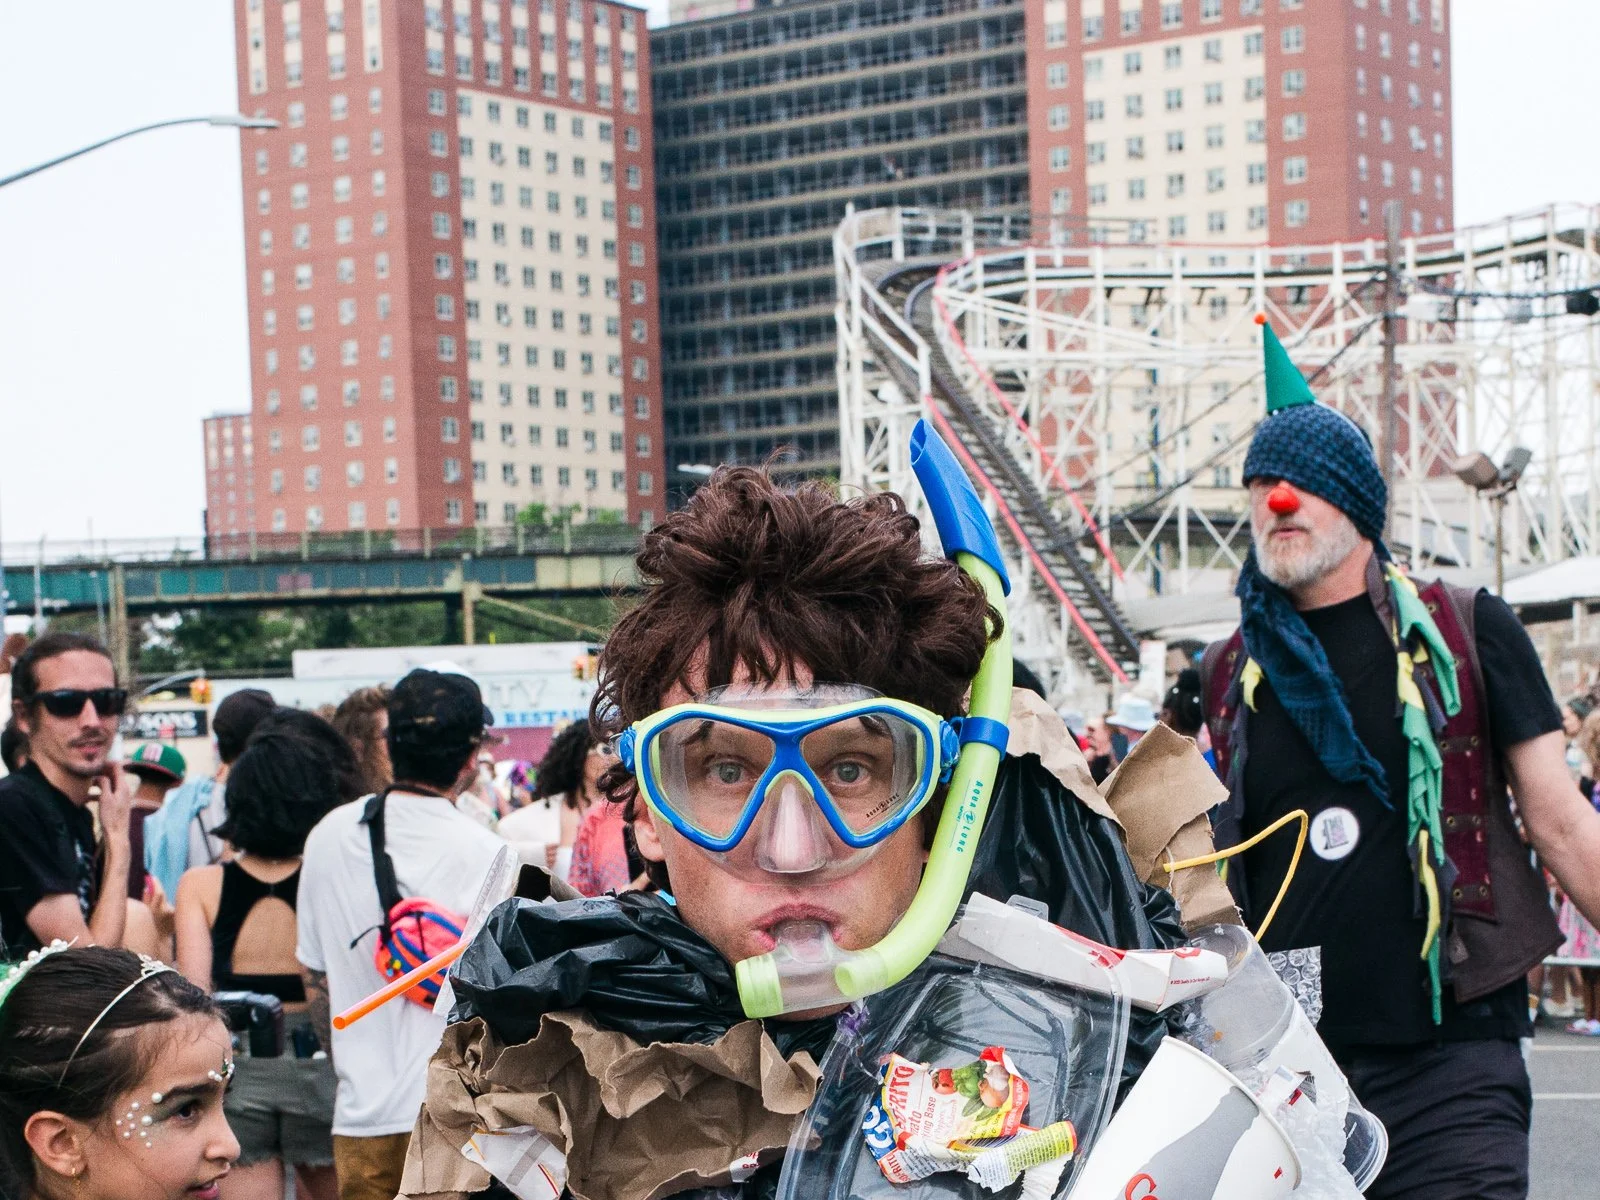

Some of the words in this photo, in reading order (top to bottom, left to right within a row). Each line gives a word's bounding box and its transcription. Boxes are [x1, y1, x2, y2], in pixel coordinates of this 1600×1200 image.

[969, 780, 984, 807] AQUA
[866, 806, 879, 818] AQUA
[956, 825, 970, 853] LUNG
[926, 1096, 937, 1120] Base
